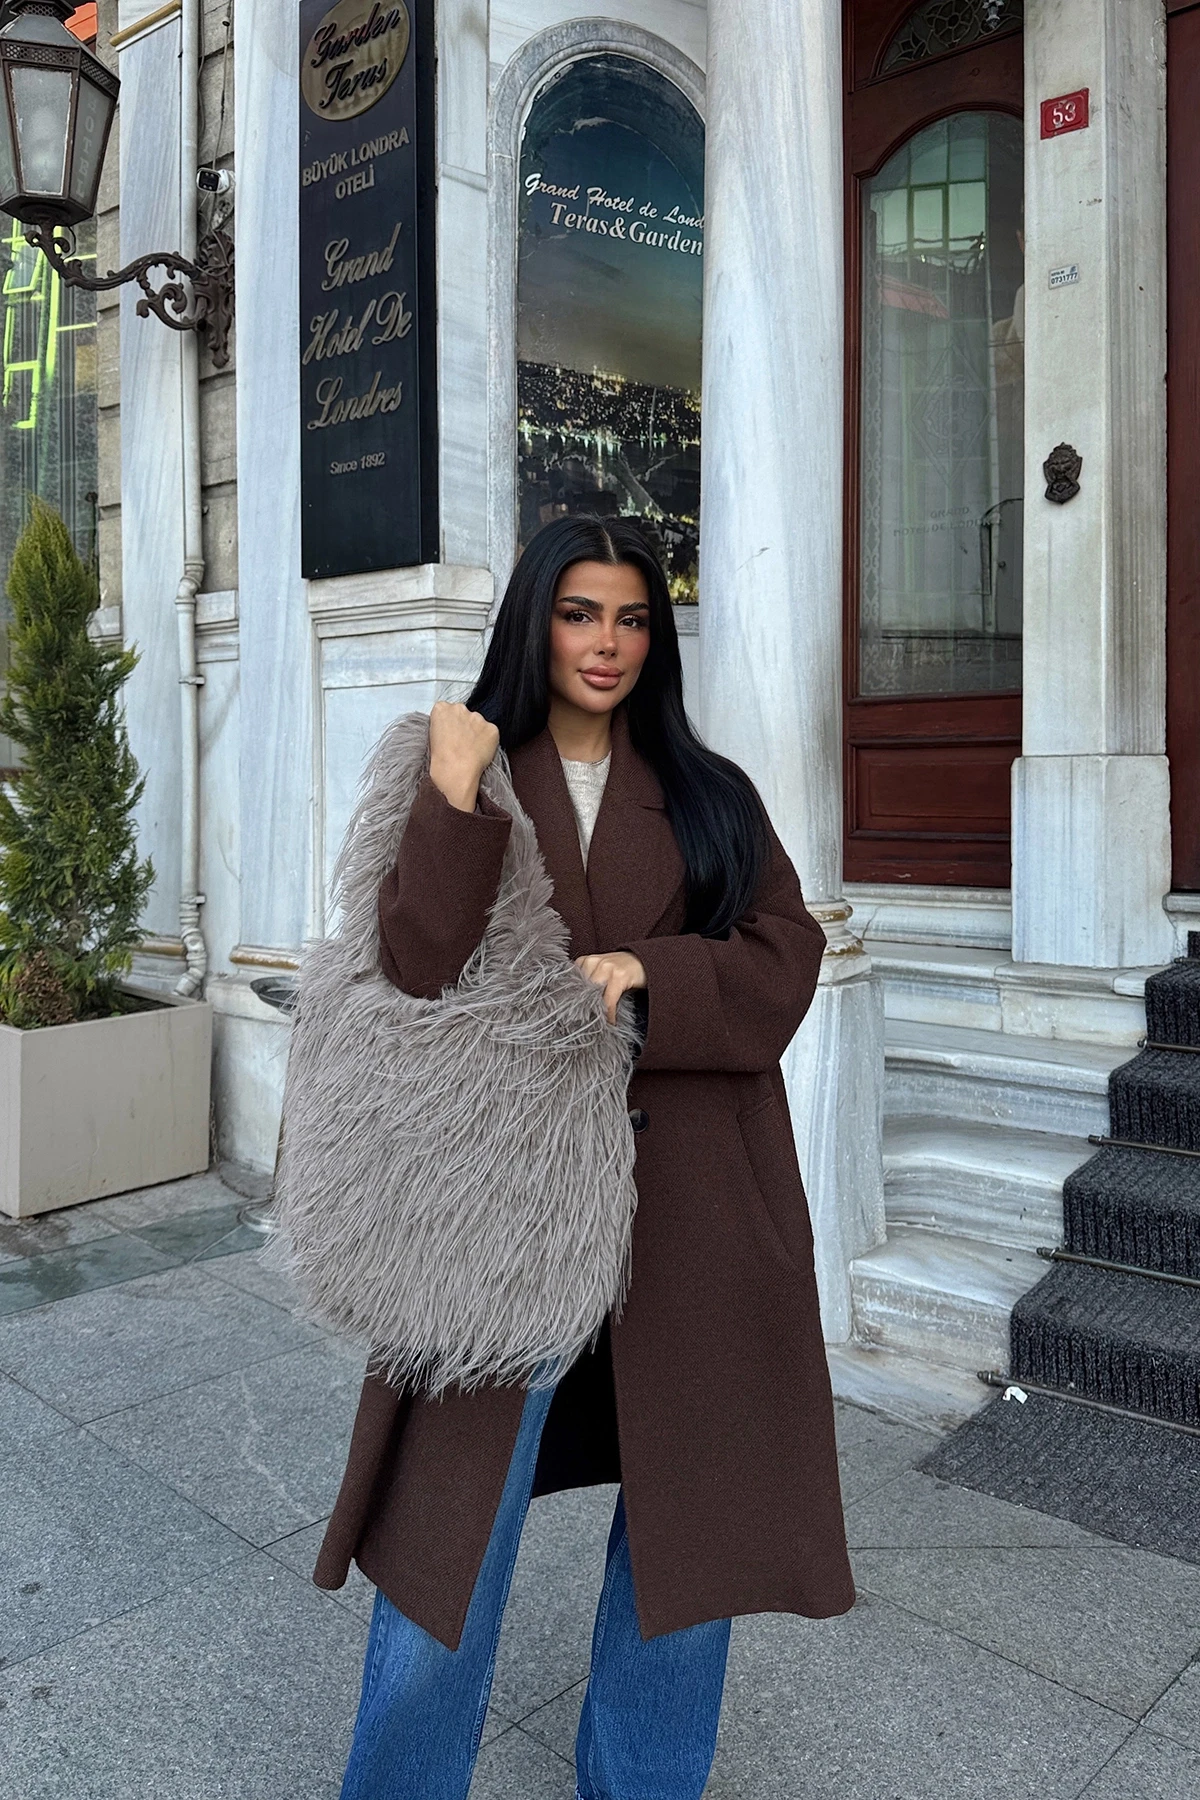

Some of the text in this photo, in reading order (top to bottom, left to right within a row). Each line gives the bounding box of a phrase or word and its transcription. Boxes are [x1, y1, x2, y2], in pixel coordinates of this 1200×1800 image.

[310, 2, 401, 68] Garden
[318, 57, 389, 109] Teras
[1052, 100, 1076, 127] 53
[302, 126, 410, 187] BÜYÜK LONDRA
[334, 163, 375, 200] OTELİ
[524, 173, 580, 200] Grand
[586, 186, 634, 214] Hotel
[638, 201, 658, 219] de
[550, 202, 703, 255] Teras&Garden
[321, 221, 403, 291] Grand
[301, 291, 413, 366] Hotel De
[307, 370, 403, 430] Londres
[329, 451, 386, 475] Since 1892
